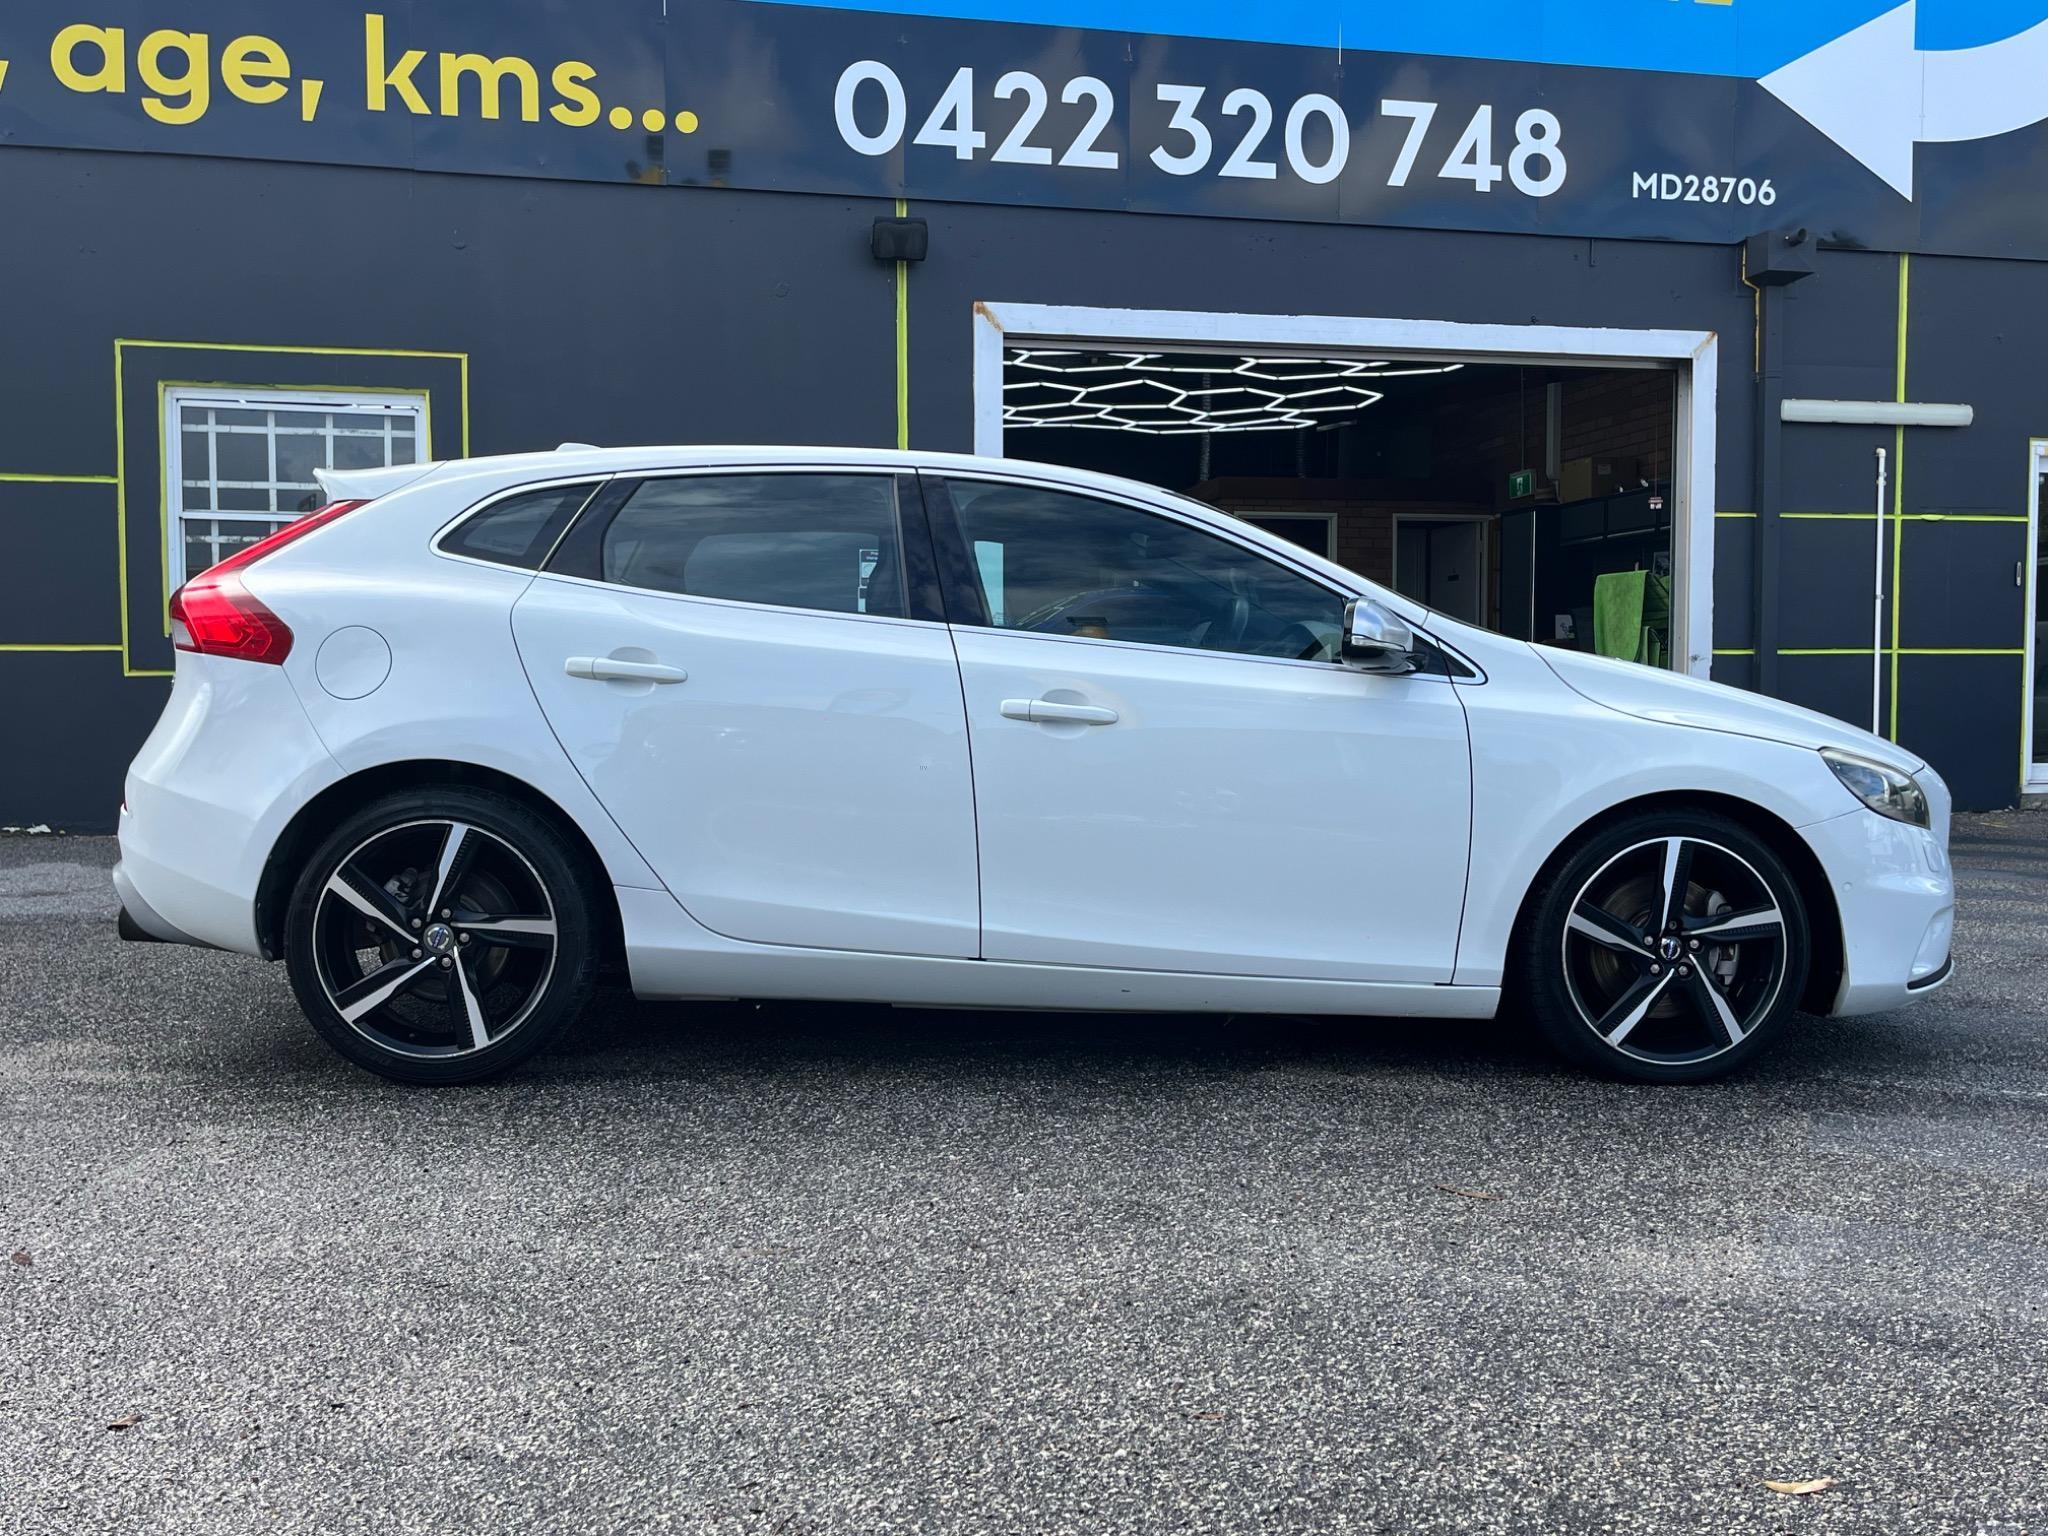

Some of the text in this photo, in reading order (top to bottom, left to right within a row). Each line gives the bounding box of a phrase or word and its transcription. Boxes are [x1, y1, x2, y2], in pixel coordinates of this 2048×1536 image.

[50, 13, 699, 134] age, kms...
[834, 60, 1567, 197] 0422 320 748
[1632, 171, 1776, 206] MD28706
